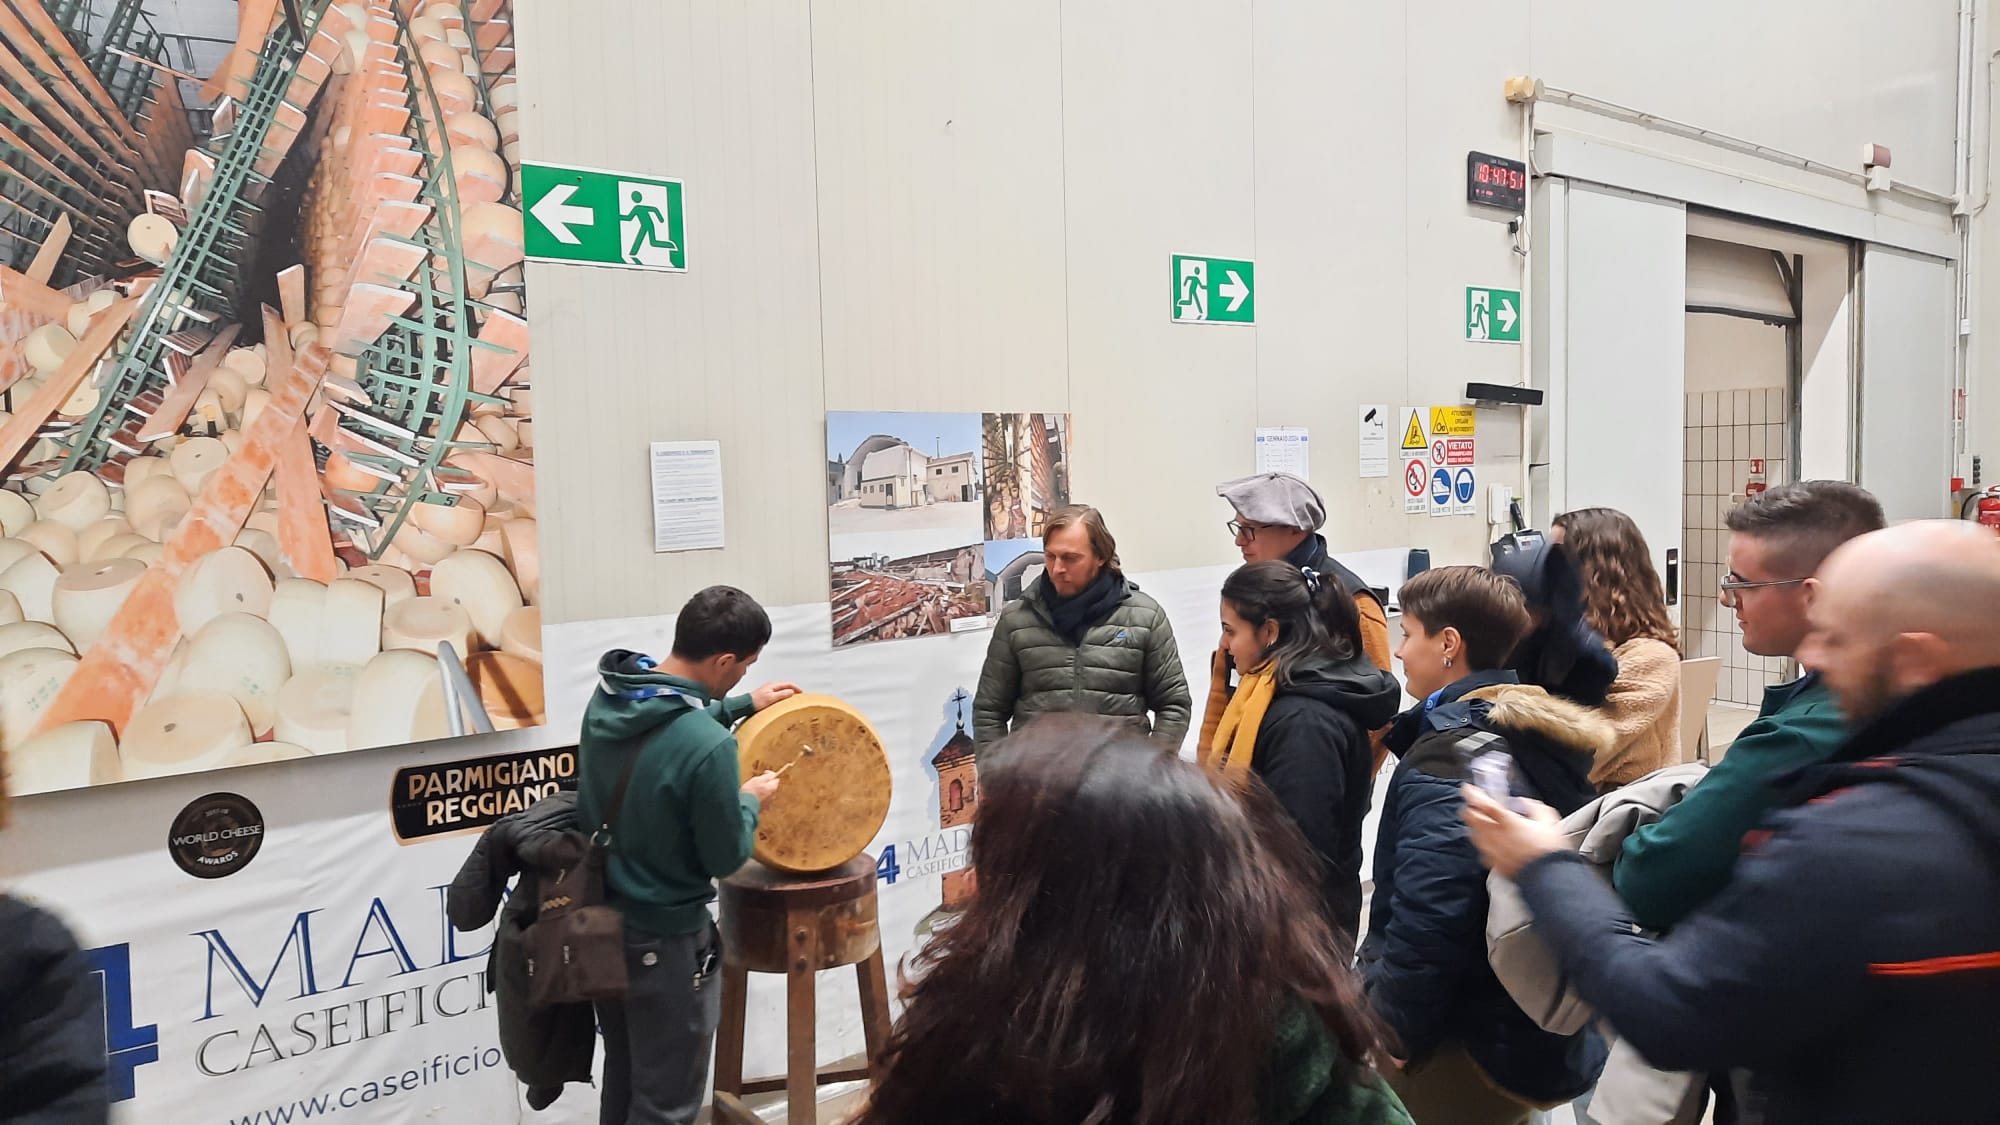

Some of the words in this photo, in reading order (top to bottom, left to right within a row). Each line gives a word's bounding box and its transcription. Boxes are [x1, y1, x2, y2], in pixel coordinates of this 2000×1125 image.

[1479, 163, 1524, 189] 10:47:51
[1448, 441, 1473, 449] VIETATO
[444, 496, 455, 506] 5
[408, 752, 575, 800] PARMIGIANO
[172, 831, 219, 846] WORLD
[220, 824, 262, 839] CHEESE
[197, 850, 239, 865] AWARDS
[877, 844, 900, 885] 4
[906, 828, 971, 865] MAD
